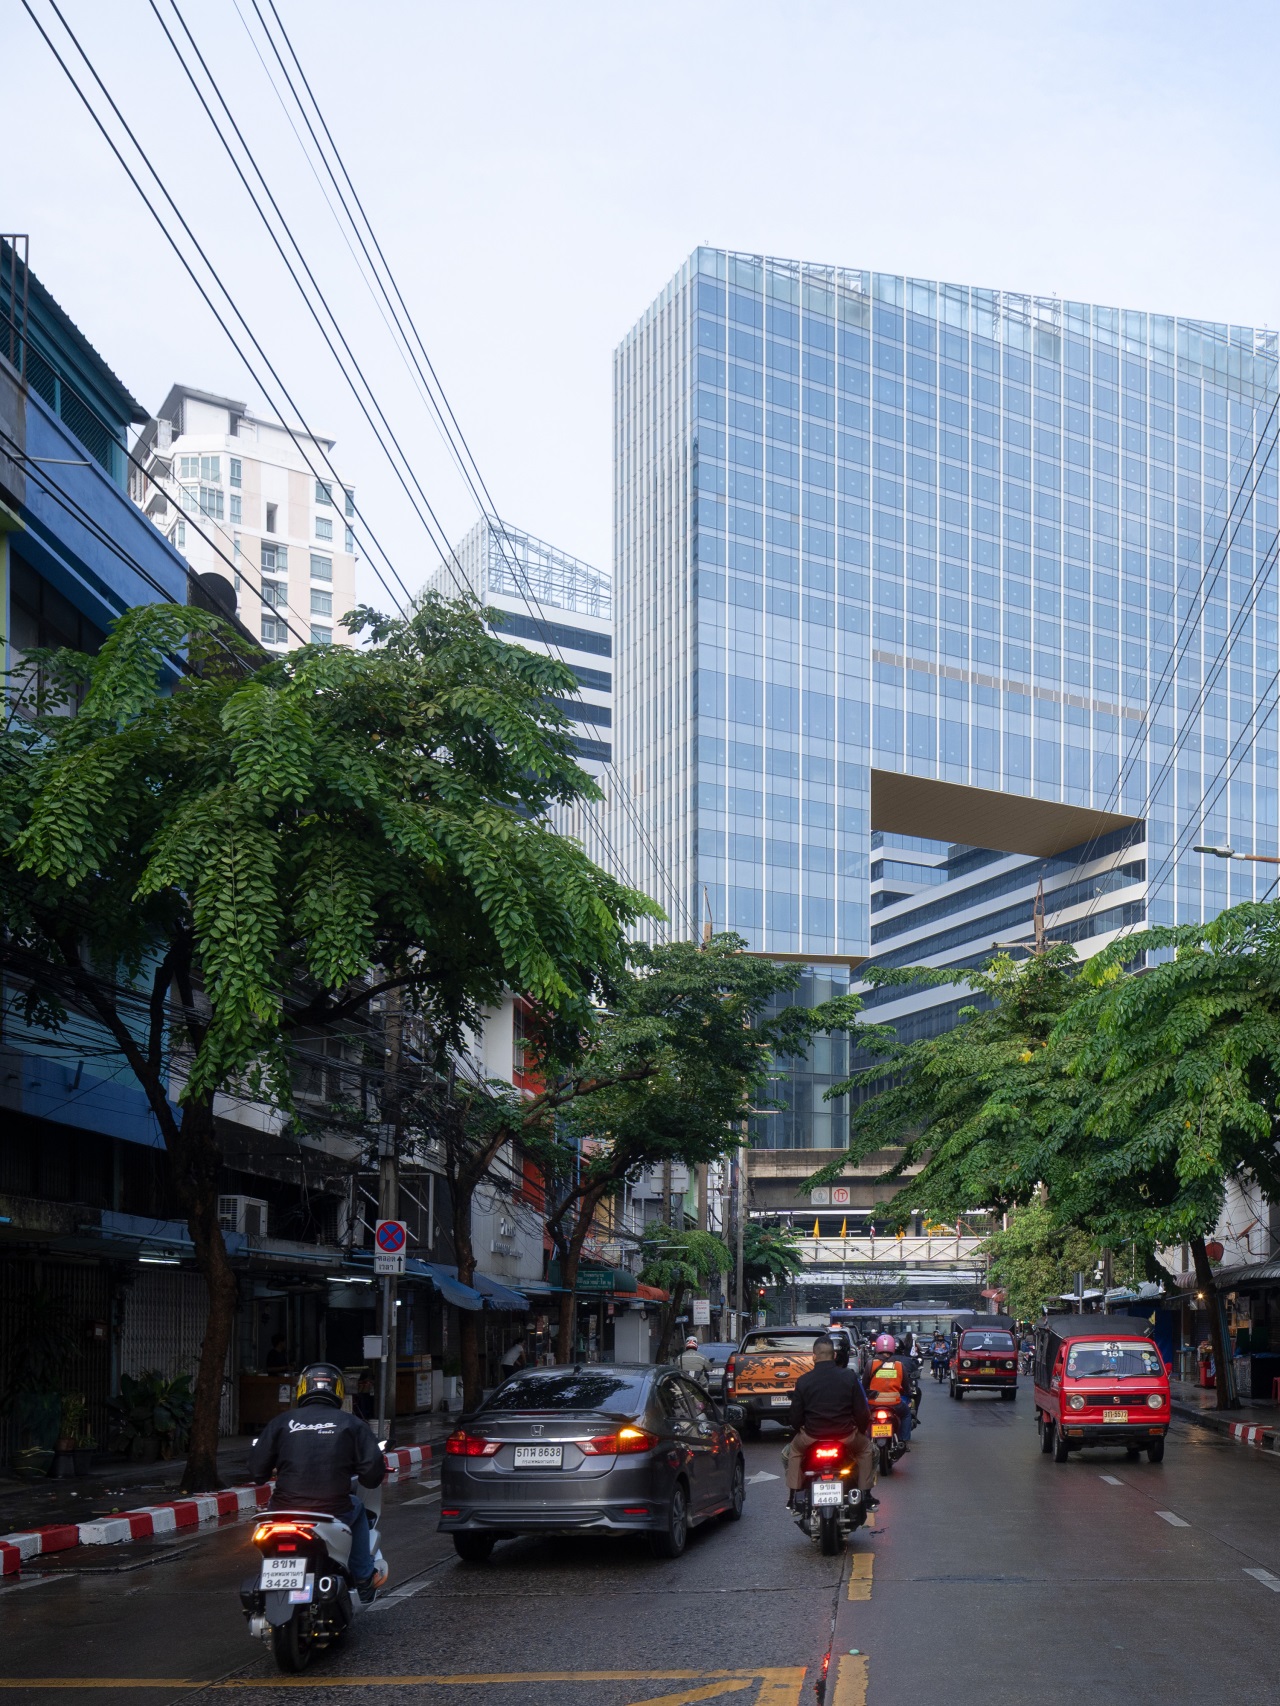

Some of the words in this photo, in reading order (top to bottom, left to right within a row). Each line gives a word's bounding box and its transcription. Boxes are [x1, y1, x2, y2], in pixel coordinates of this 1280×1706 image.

[289, 1420, 337, 1433] Vespa
[538, 1448, 561, 1457] 8638
[266, 1579, 298, 1588] 3428
